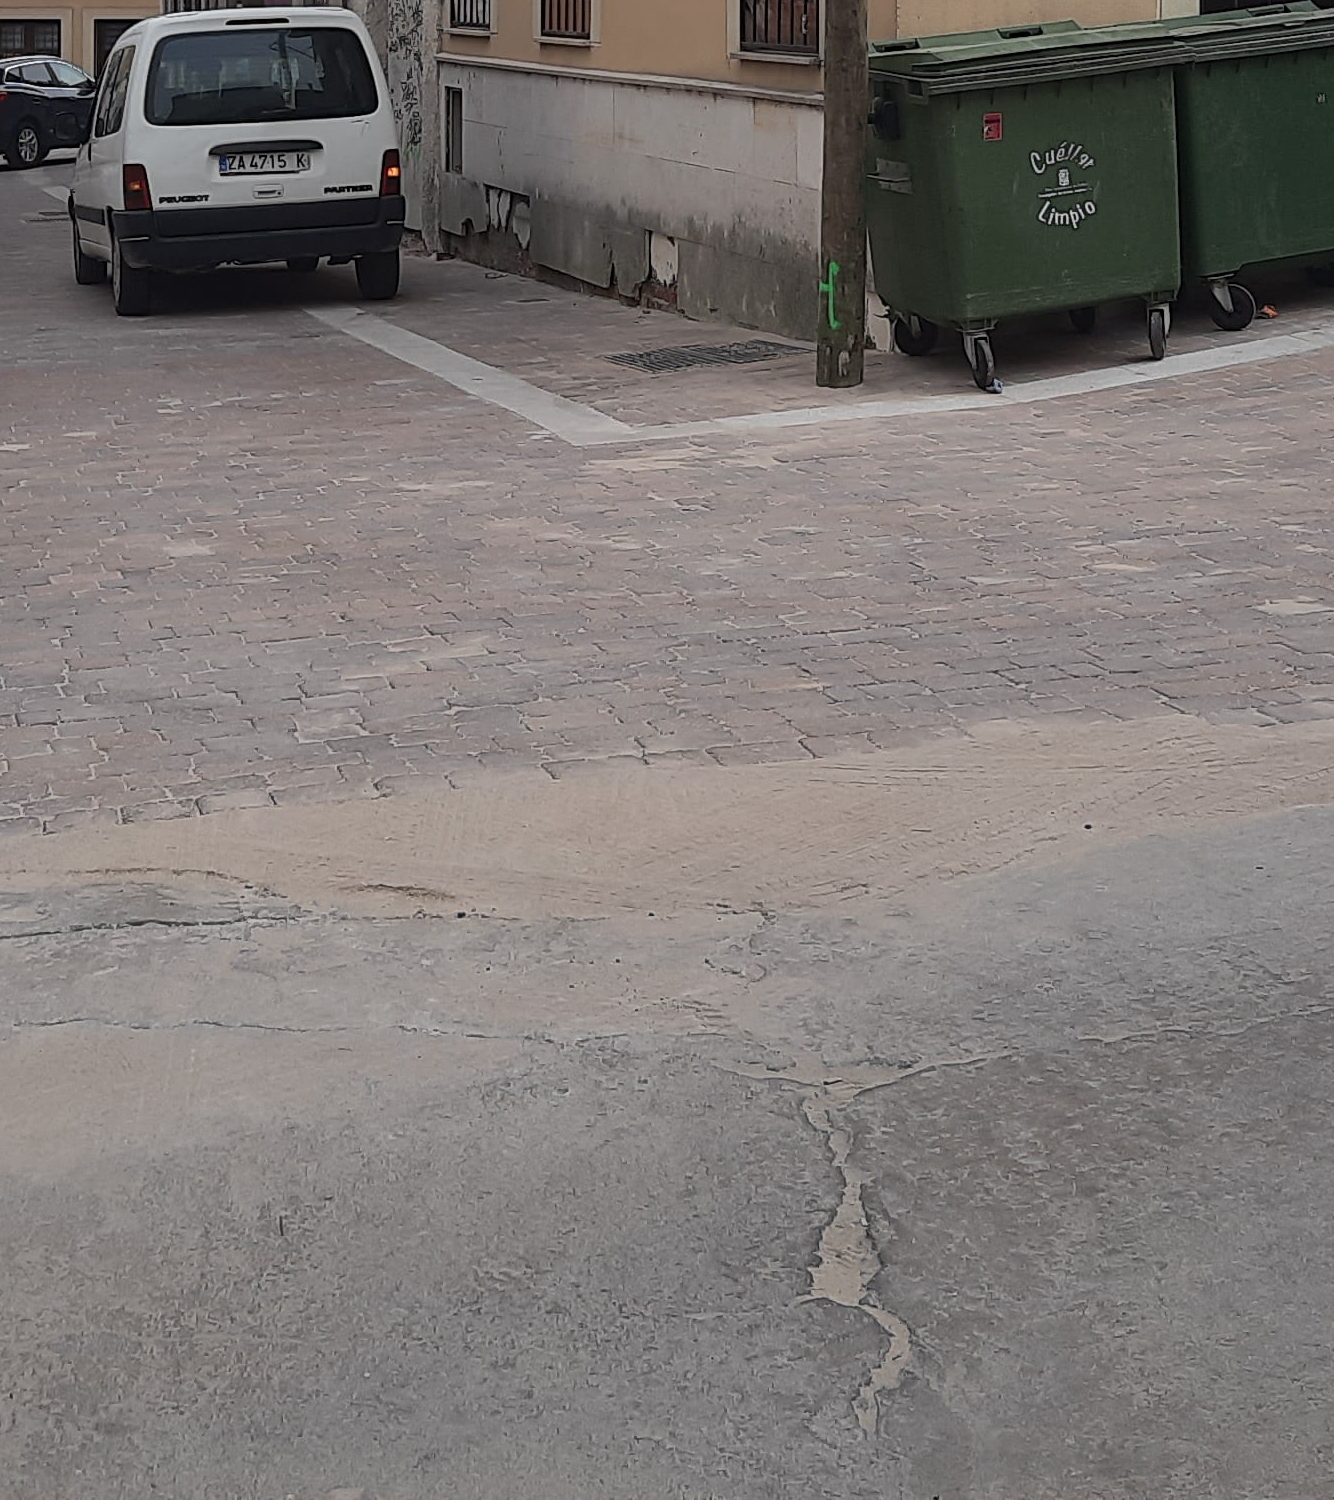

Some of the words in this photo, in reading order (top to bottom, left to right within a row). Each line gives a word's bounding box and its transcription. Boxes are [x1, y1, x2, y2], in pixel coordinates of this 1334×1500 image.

[228, 155, 246, 170] ZA
[249, 154, 287, 169] 4715
[296, 153, 306, 168] K
[1029, 141, 1096, 174] Cuéllar
[158, 194, 210, 205] PEUGEOT
[1038, 200, 1096, 229] Limpio
